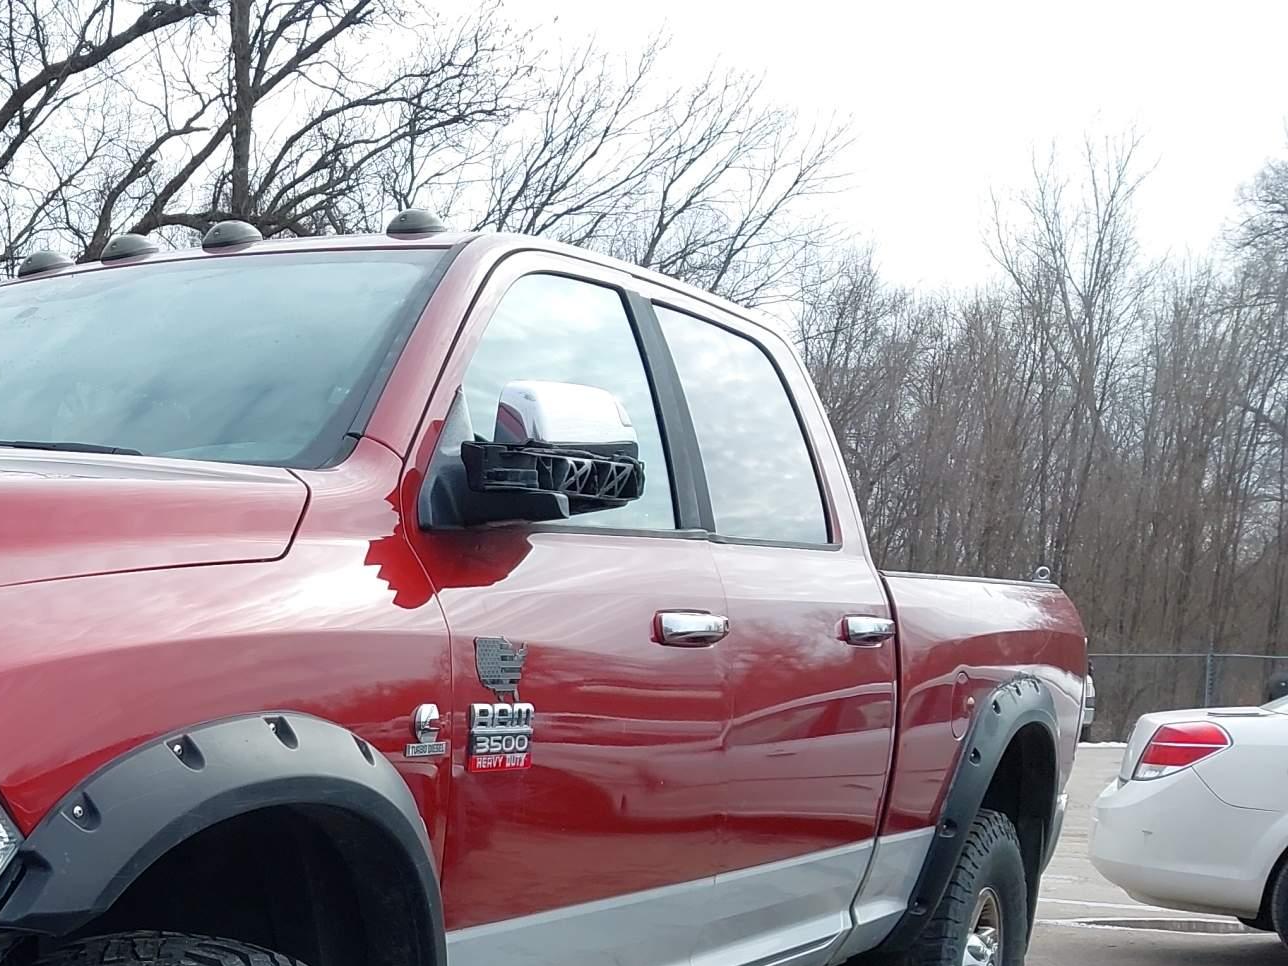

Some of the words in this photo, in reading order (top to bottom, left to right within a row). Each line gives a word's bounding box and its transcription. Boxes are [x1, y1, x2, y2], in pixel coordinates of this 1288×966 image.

[471, 703, 534, 728] RAM
[476, 735, 528, 753] 3500
[476, 755, 503, 769] HEAVY
[505, 753, 527, 767] DUTY
